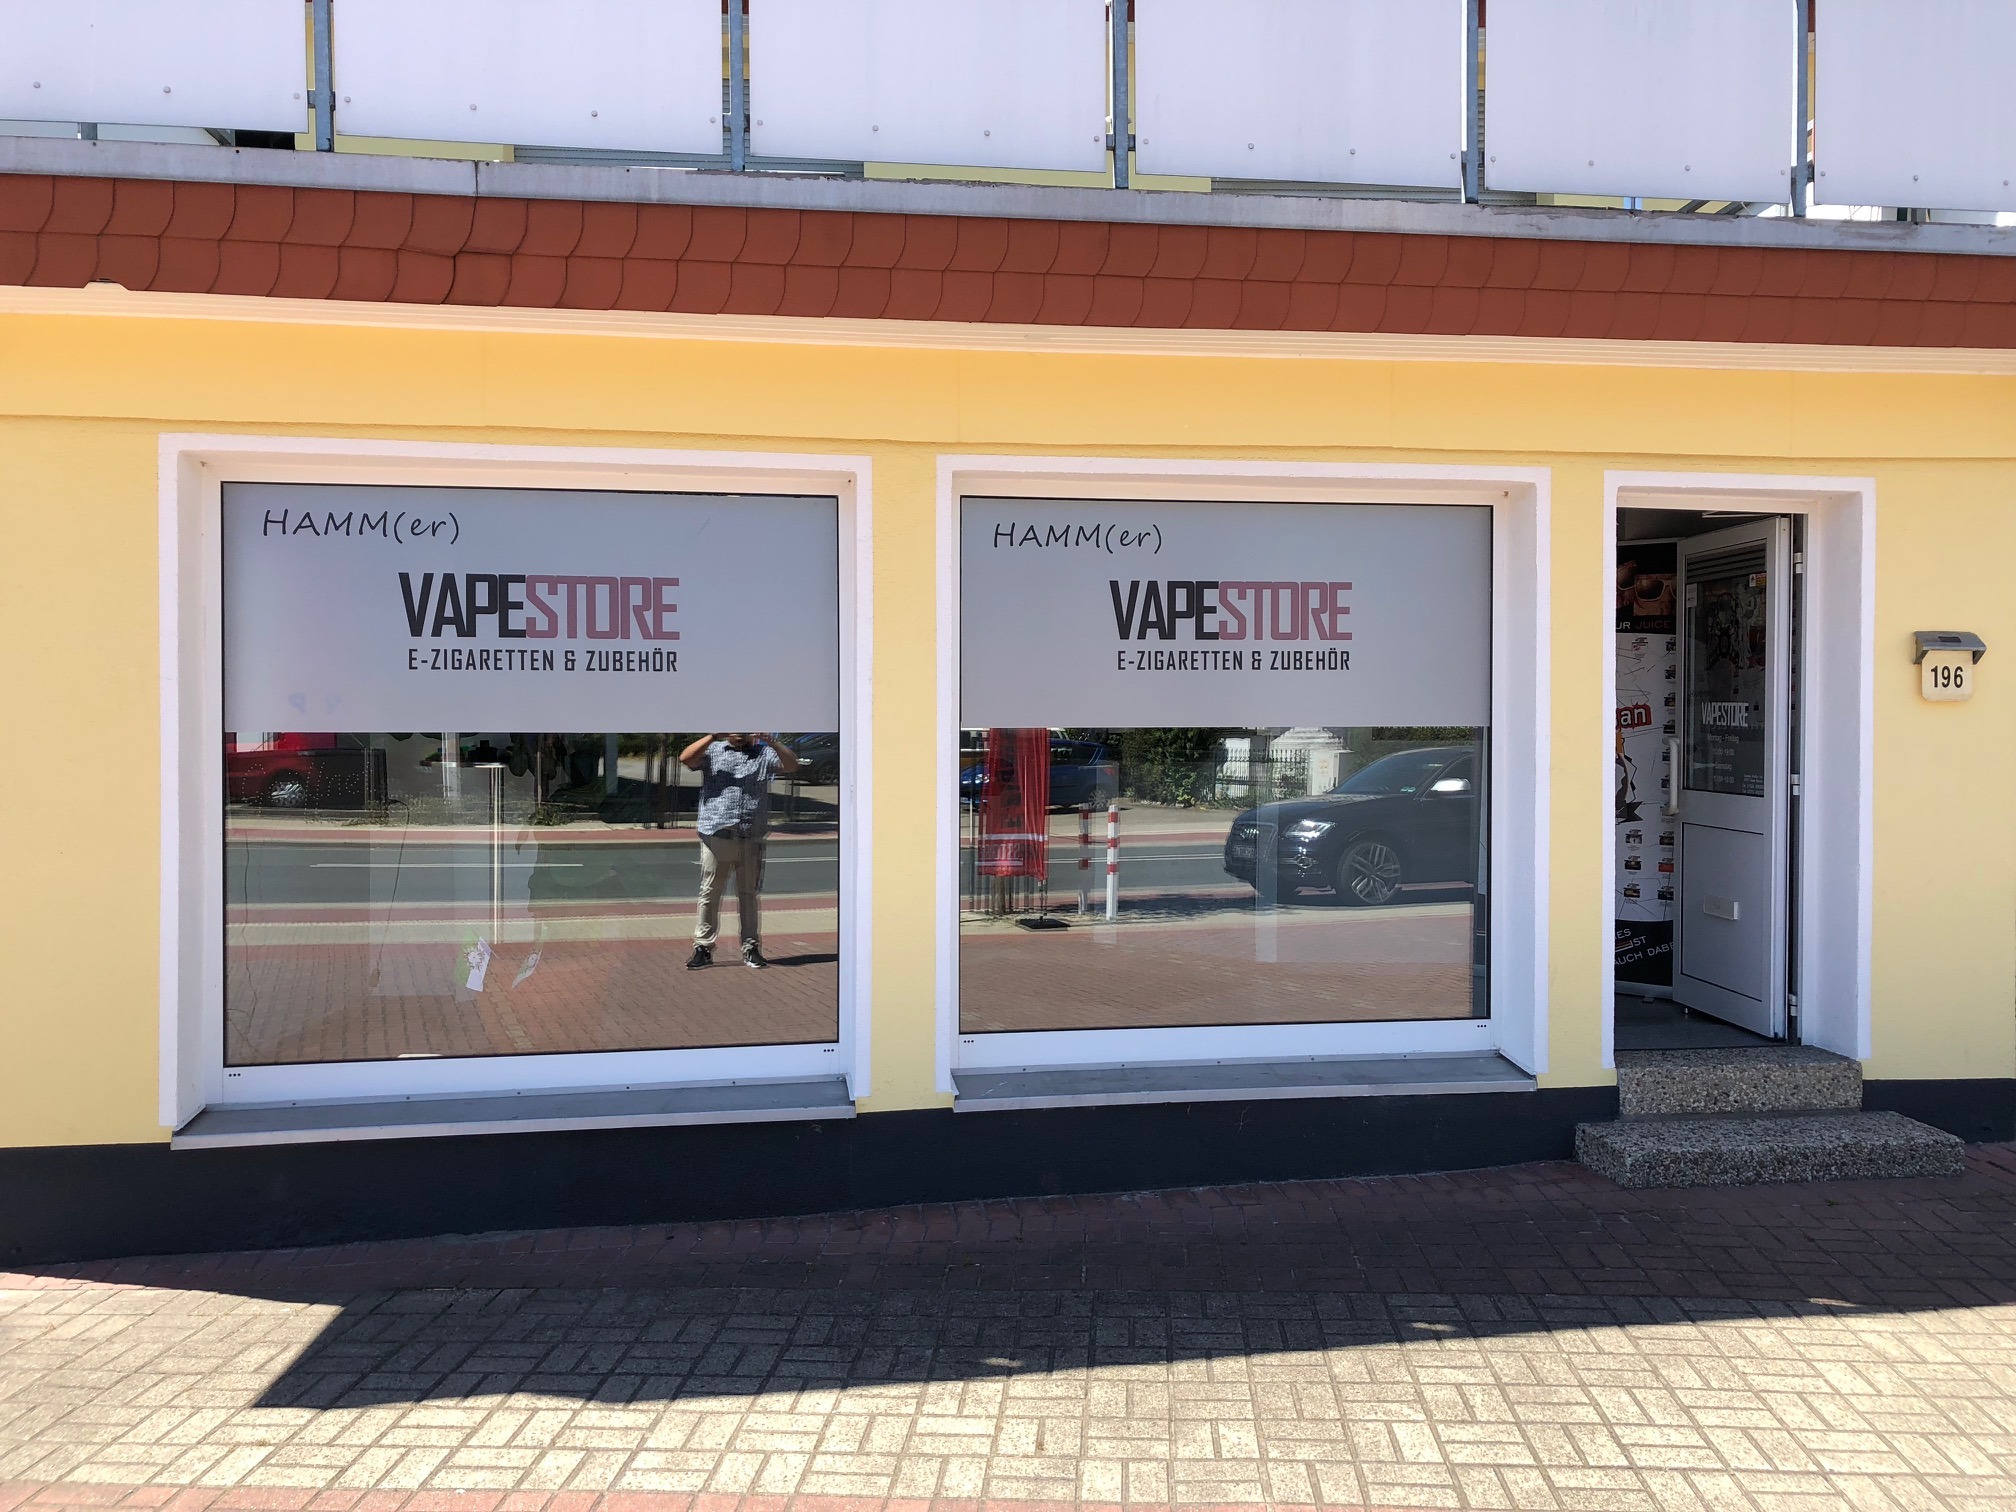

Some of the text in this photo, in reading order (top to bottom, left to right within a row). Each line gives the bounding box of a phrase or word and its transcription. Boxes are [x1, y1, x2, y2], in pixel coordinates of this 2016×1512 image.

[263, 508, 460, 545] HAMM(er)
[994, 521, 1163, 555] HAMM(er)
[398, 571, 681, 641] VAPESTORE
[1109, 579, 1354, 641] VAPESTORE
[1635, 620, 1671, 629] JUICE
[408, 647, 678, 673] E-ZIGARETTEN & ZUBEHÖR
[1117, 647, 1351, 671] E-ZIGARETTEN & ZUBEHÖR
[1930, 665, 1963, 688] 196
[1701, 702, 1750, 727] VAPESTORE
[1615, 928, 1632, 940] ES
